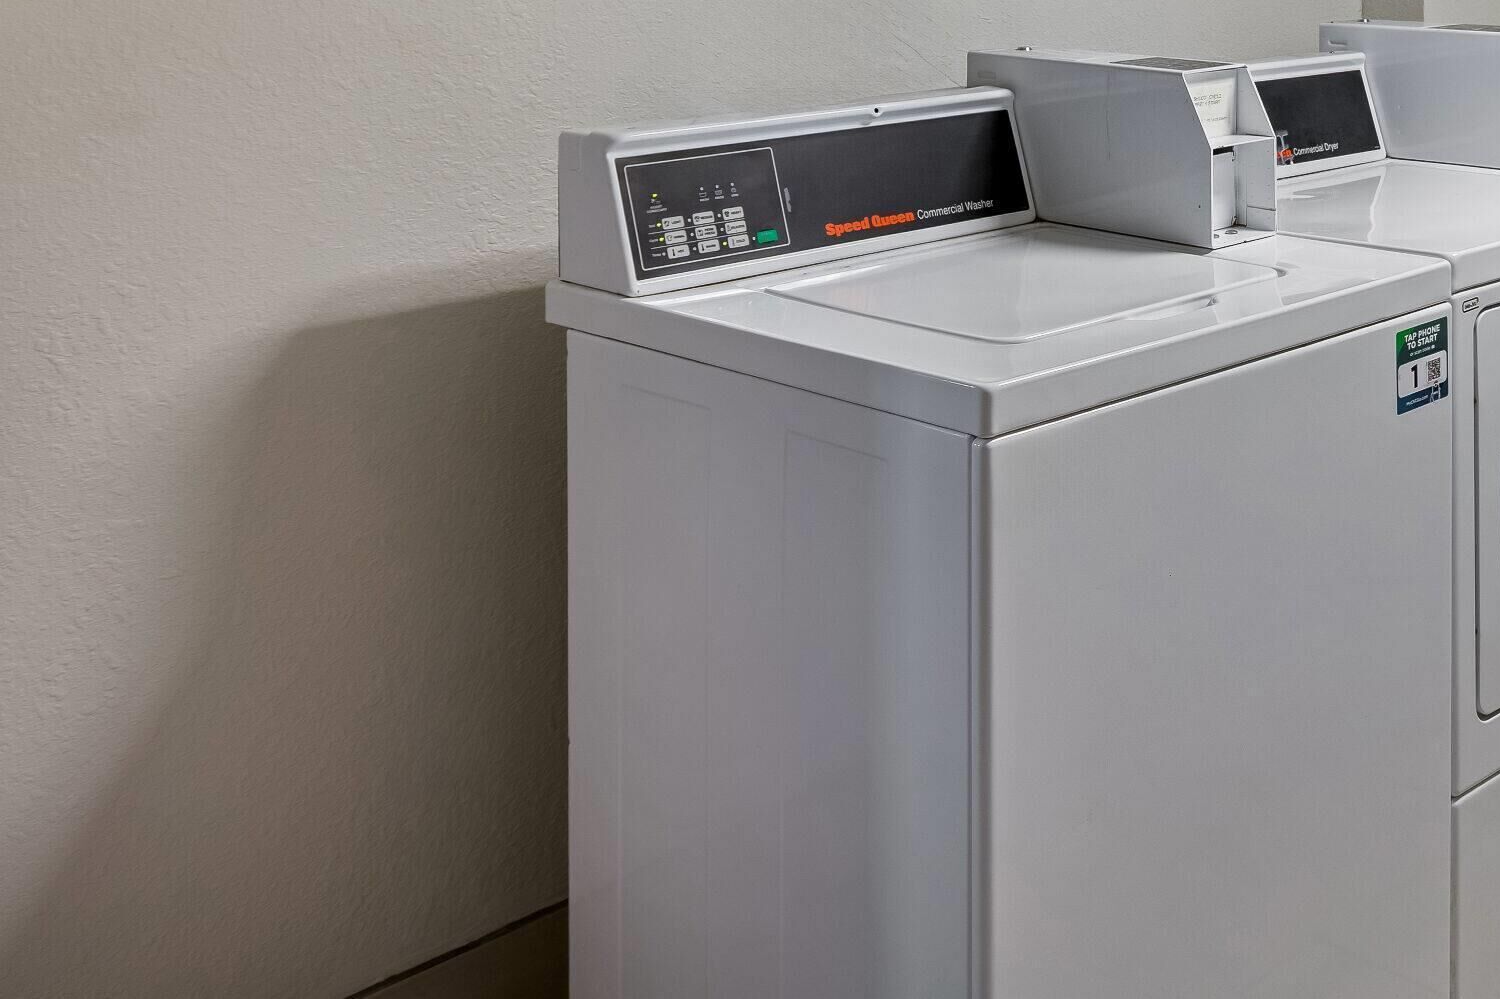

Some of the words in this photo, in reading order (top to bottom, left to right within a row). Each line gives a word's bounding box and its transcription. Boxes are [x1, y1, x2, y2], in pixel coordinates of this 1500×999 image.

[1293, 144, 1324, 156] Commercial
[1324, 142, 1339, 152] Dryer
[825, 217, 870, 237] Speed
[871, 211, 914, 228] Queen
[917, 202, 964, 220] Commercial
[965, 199, 993, 211] Washer
[1404, 332, 1417, 343] TAP
[1418, 324, 1441, 338] PHONE
[1407, 341, 1416, 350] TO
[1417, 333, 1438, 347] START
[1411, 364, 1418, 389] 1
